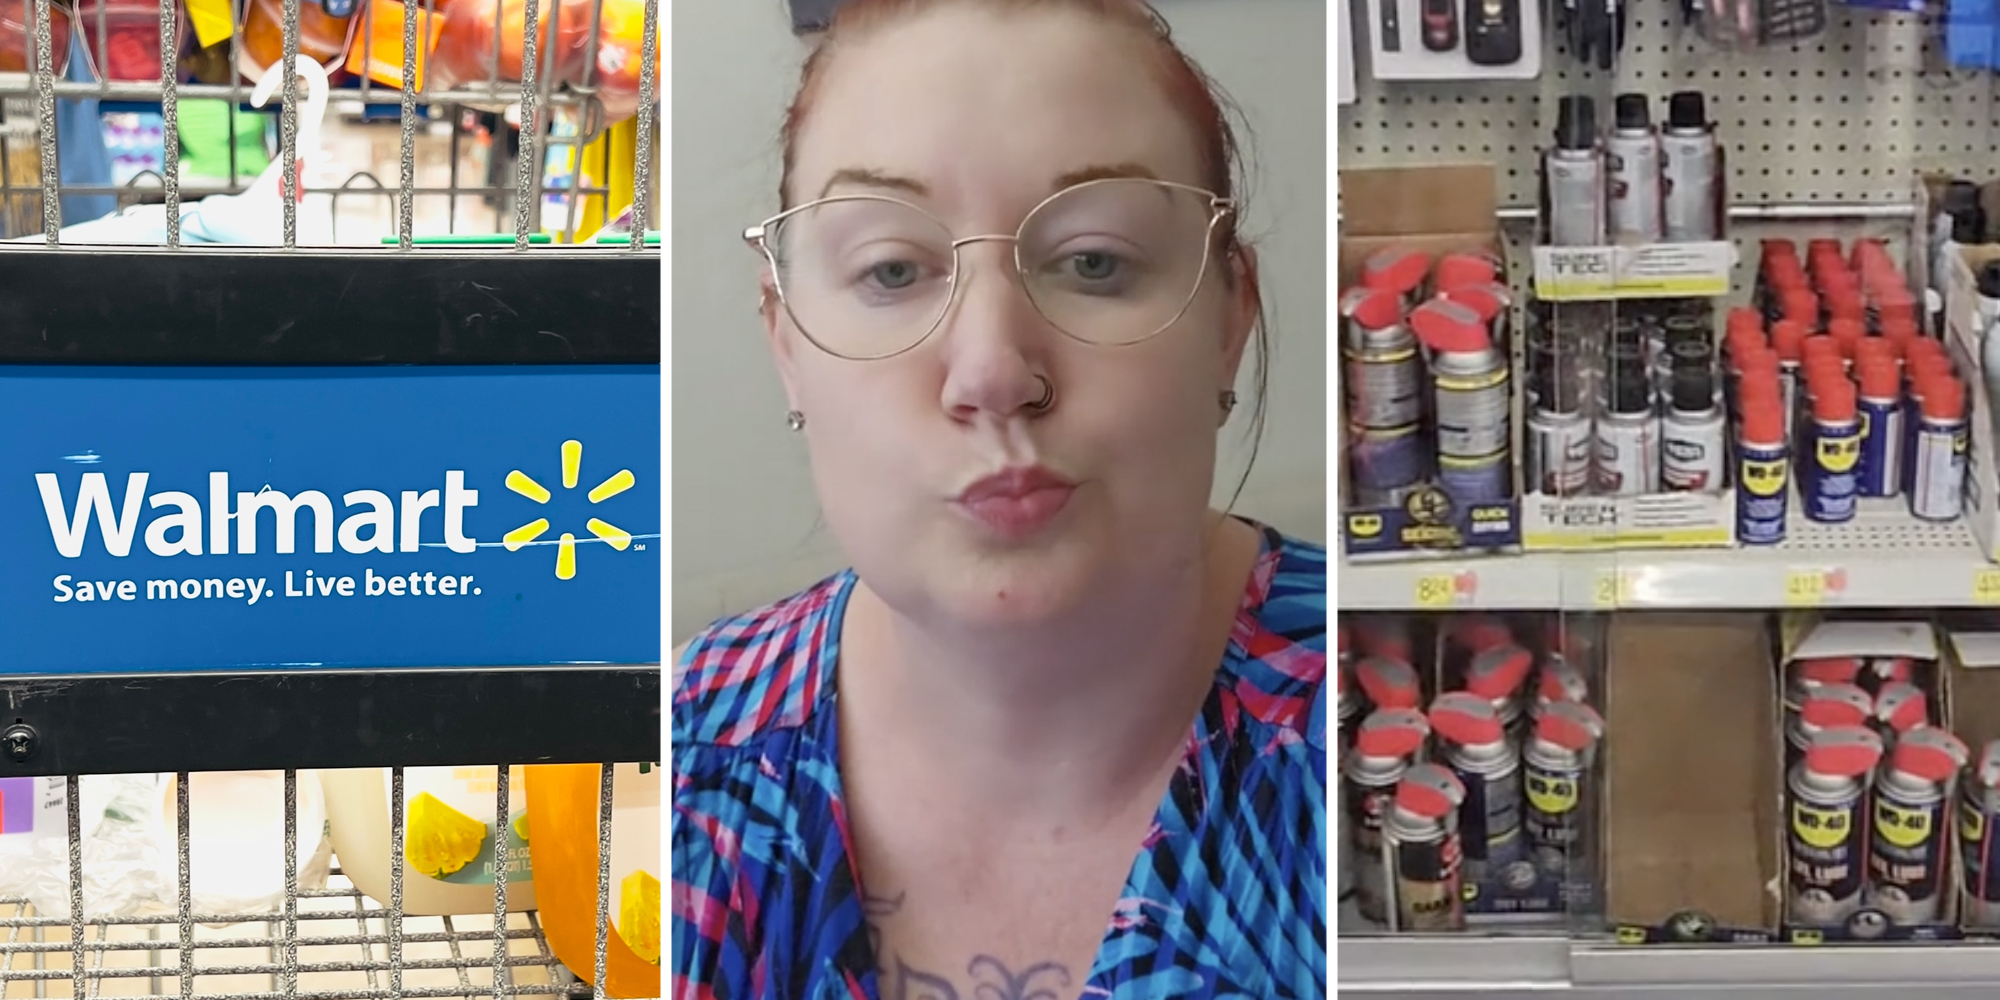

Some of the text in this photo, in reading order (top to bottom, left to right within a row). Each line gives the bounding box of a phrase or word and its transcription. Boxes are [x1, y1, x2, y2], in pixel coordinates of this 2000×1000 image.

[35, 470, 479, 558] Walmart
[53, 567, 482, 606] Save money. Live better.
[1799, 808, 1845, 830] WD-40
[1880, 805, 1926, 830] WD-40
